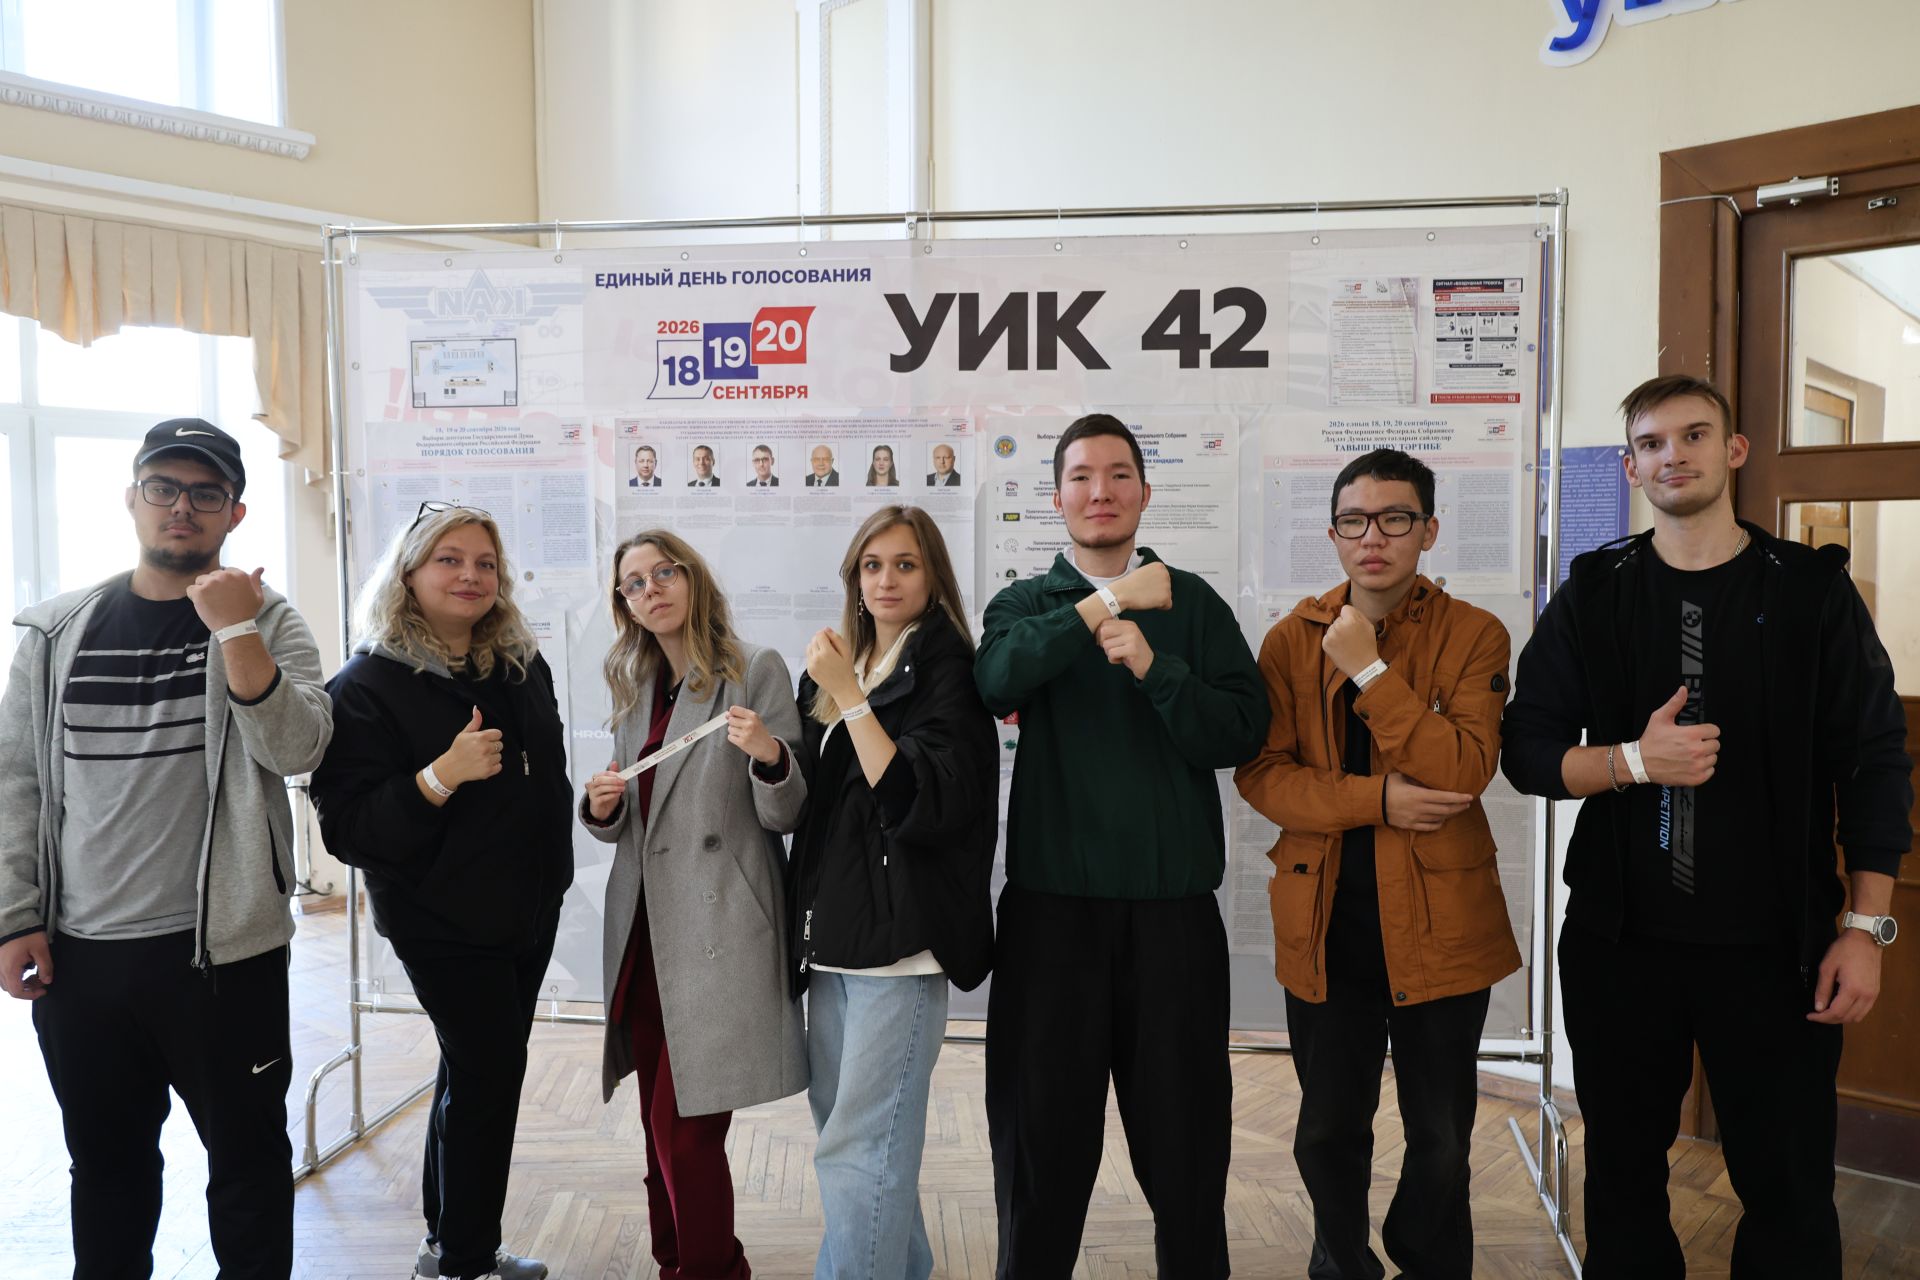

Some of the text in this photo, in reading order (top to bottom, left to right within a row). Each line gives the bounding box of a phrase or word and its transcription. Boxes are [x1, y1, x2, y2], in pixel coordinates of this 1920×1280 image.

[595, 267, 872, 289] ЕДИНЫЙ ДЕНЬ ГОЛОСОВАНИЯ
[657, 320, 700, 334] 2026
[756, 319, 803, 352] 20
[883, 290, 1112, 374] УИК
[1141, 286, 1269, 369] 42
[708, 336, 747, 369] 19
[662, 355, 701, 387] 18
[712, 385, 809, 400] СЕНТЯБРЯ
[421, 447, 535, 457] ПОРЯДОК ГОЛОСОВАНИЯ
[1659, 784, 1672, 851] MPETITION
